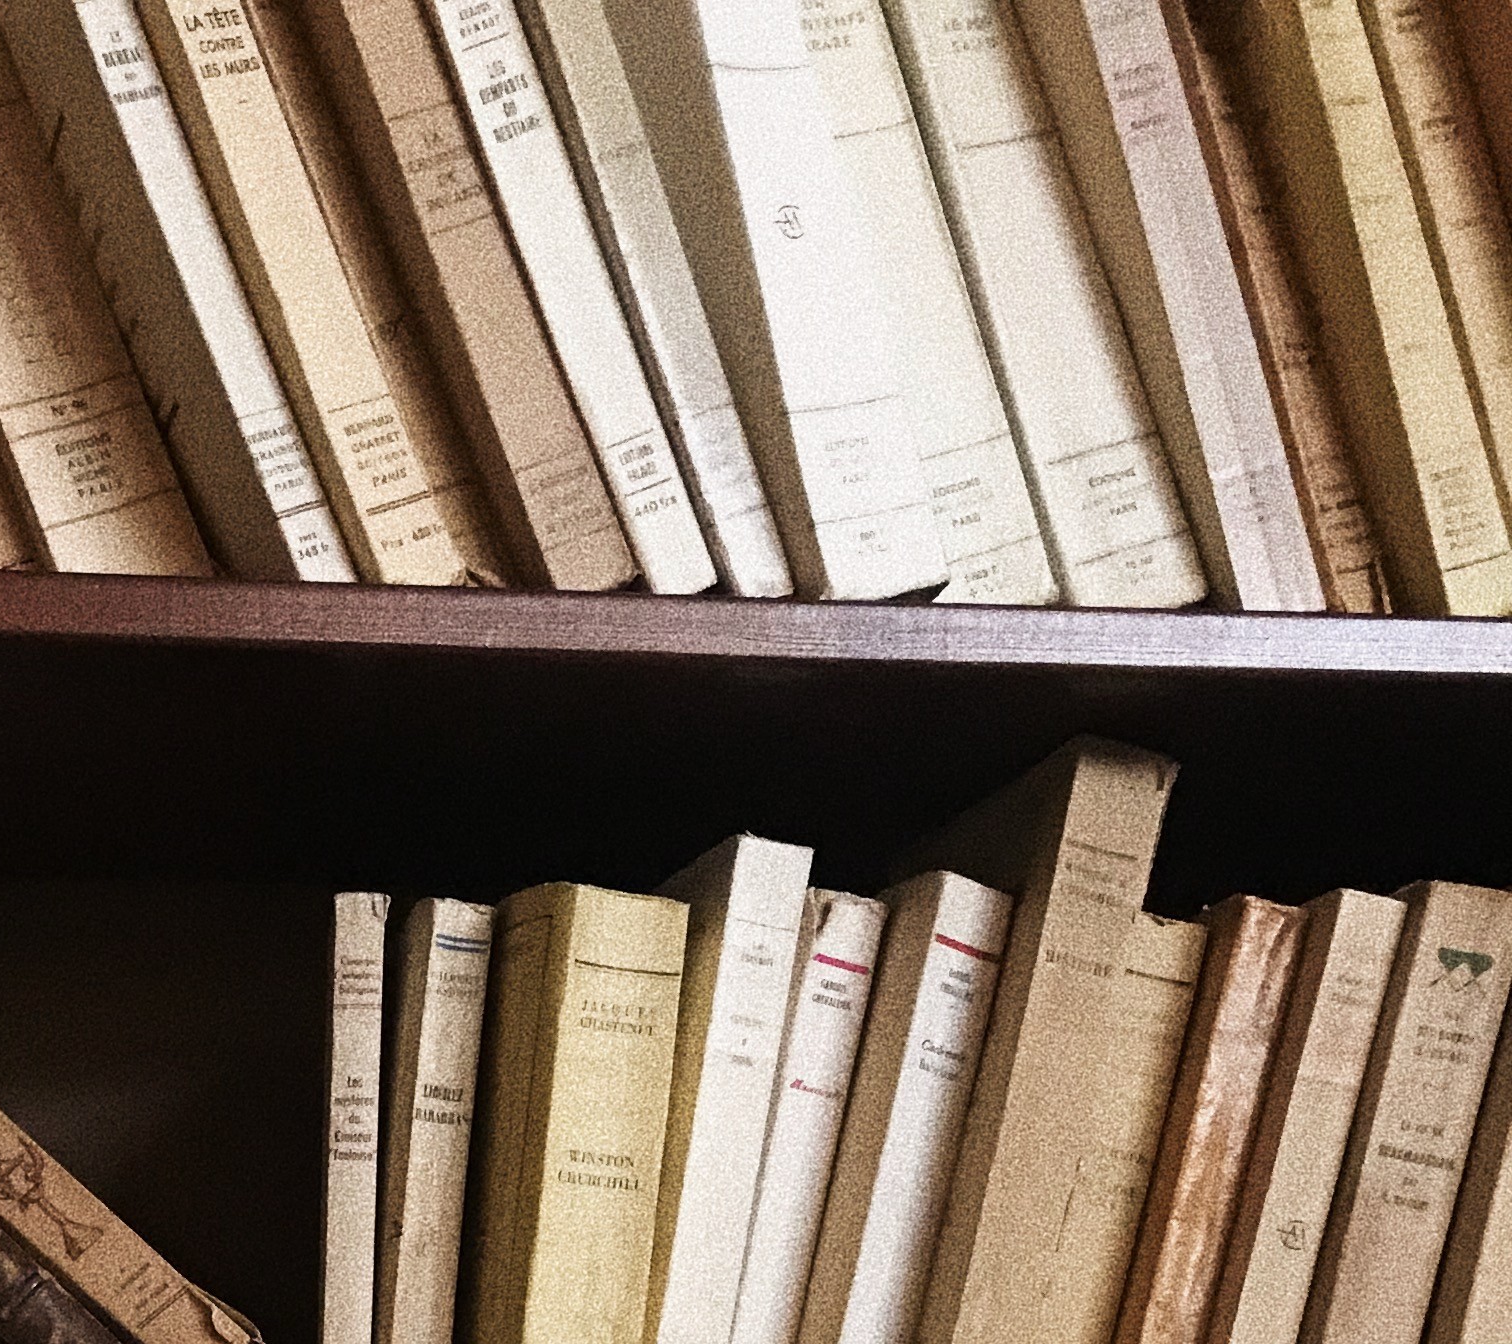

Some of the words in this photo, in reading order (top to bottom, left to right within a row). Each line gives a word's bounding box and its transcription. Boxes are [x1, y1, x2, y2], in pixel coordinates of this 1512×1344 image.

[184, 15, 203, 31] LA
[199, 60, 221, 79] LES
[225, 56, 262, 76] MURS
[568, 1149, 636, 1169] WINSTON
